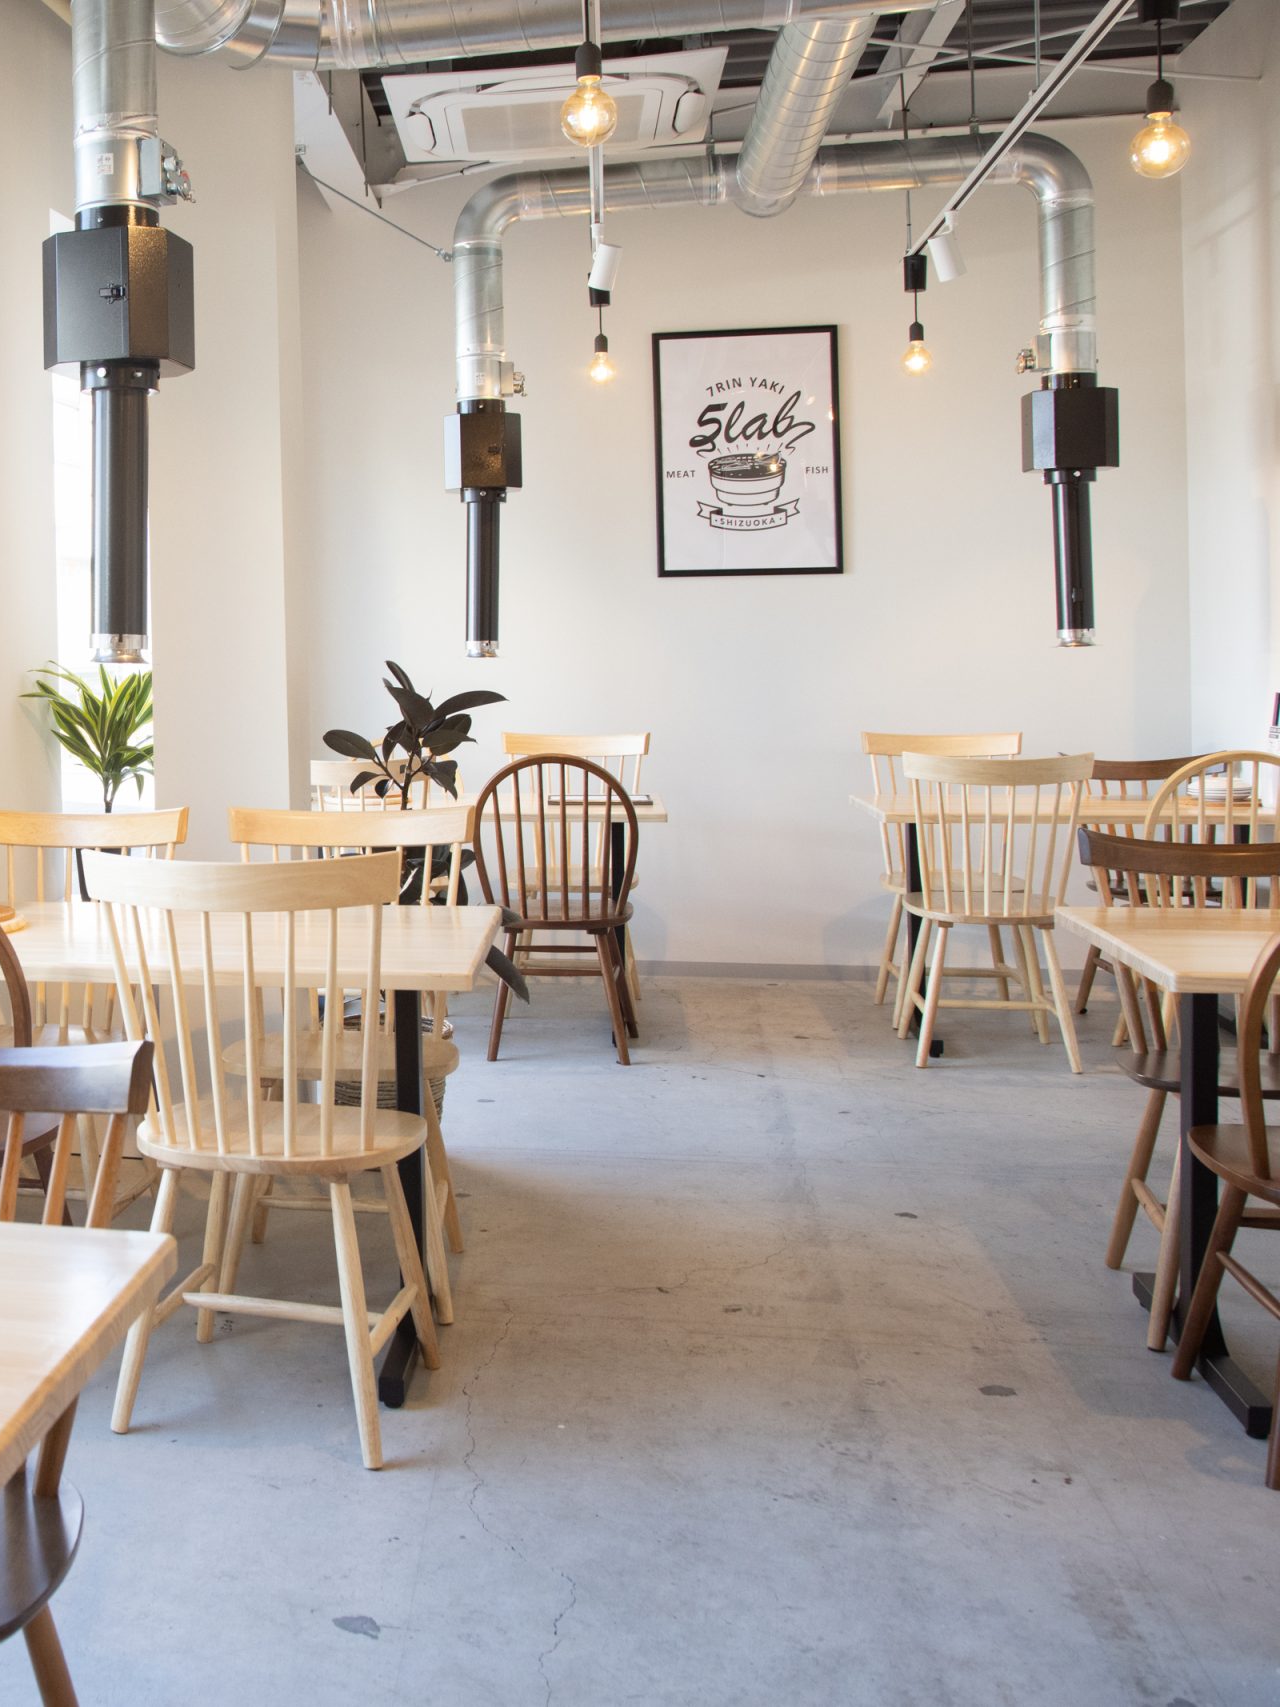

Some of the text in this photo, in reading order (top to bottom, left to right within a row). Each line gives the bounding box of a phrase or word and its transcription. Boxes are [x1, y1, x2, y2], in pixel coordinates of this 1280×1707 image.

[706, 376, 786, 397] 7RIN YAKI
[666, 470, 696, 479] MEAT
[805, 466, 829, 475] FISH
[720, 516, 776, 527] SHIZUOKA
